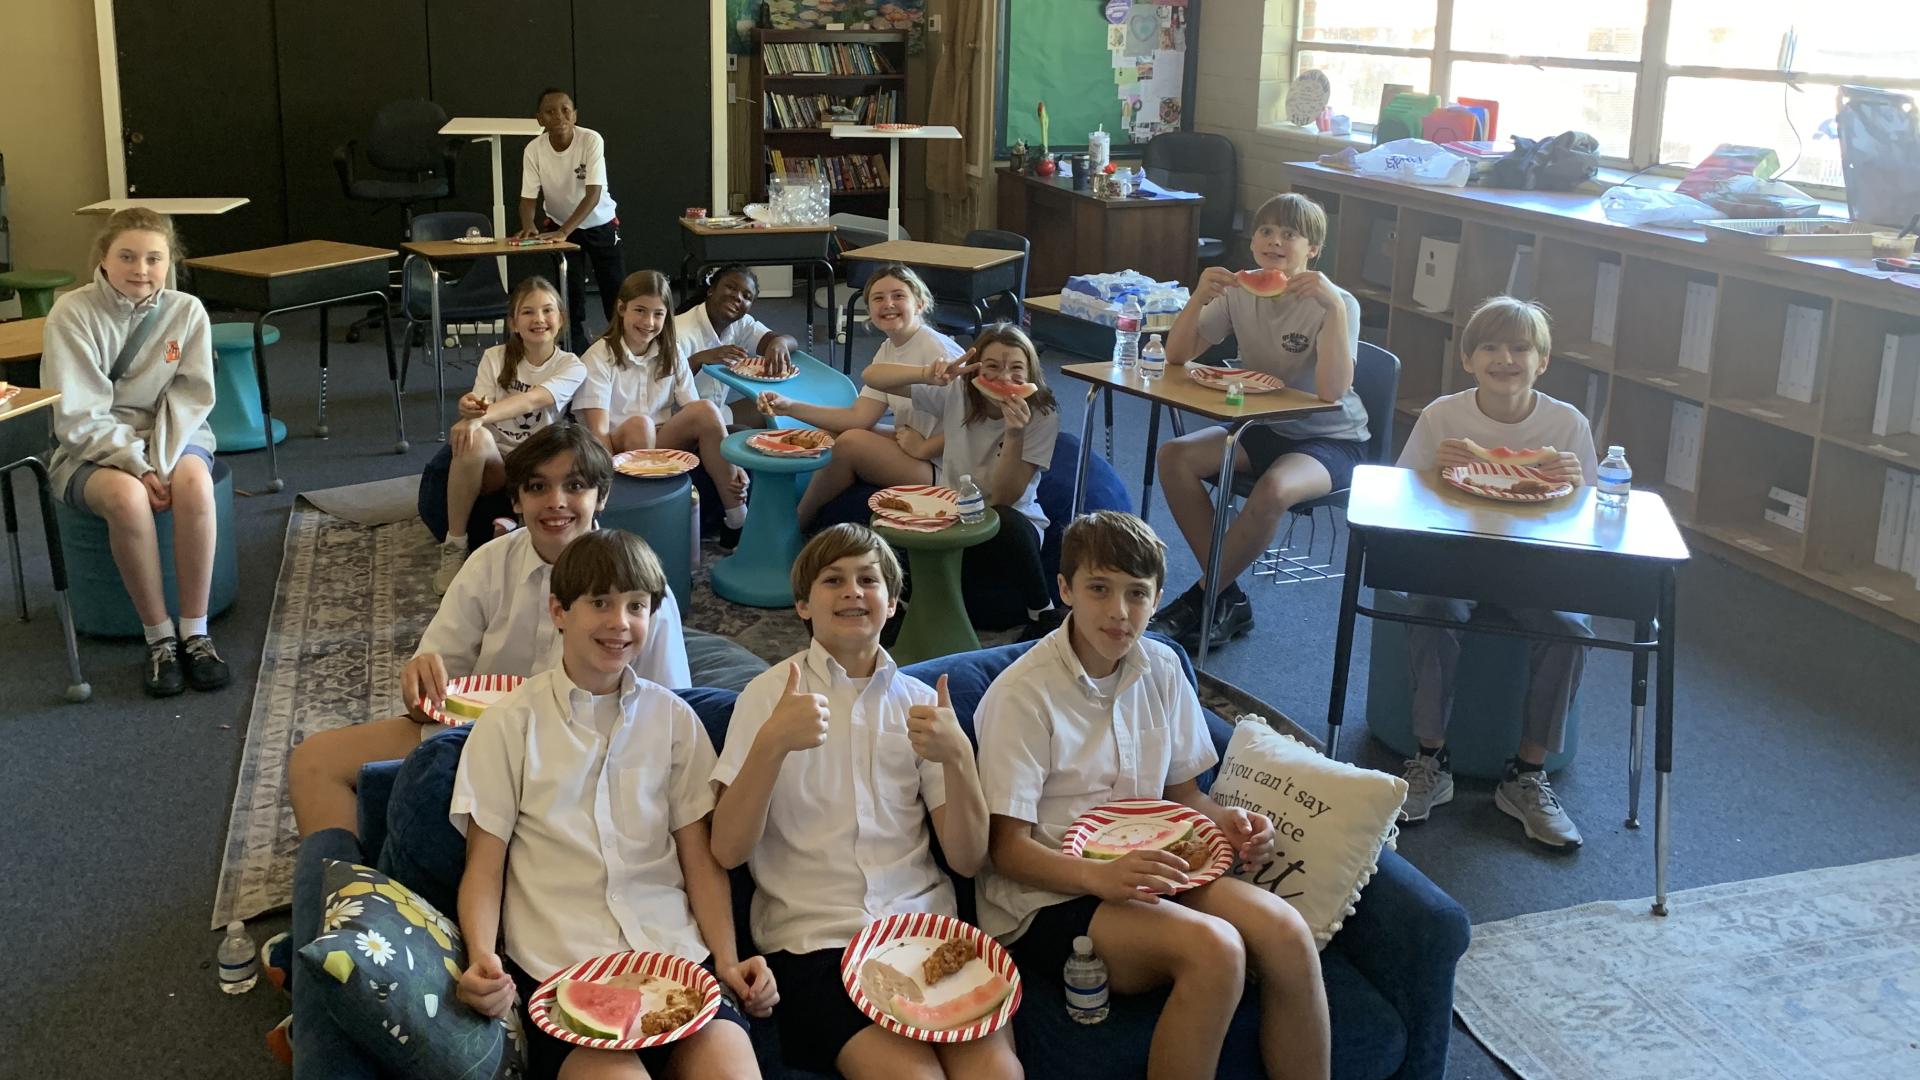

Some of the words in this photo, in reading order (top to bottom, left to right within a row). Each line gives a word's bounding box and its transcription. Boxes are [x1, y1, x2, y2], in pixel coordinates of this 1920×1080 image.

[1214, 790, 1263, 813] anything
[1266, 810, 1305, 842] nice
[1227, 762, 1253, 781] you
[1254, 770, 1295, 796] can't
[1295, 789, 1332, 818] say
